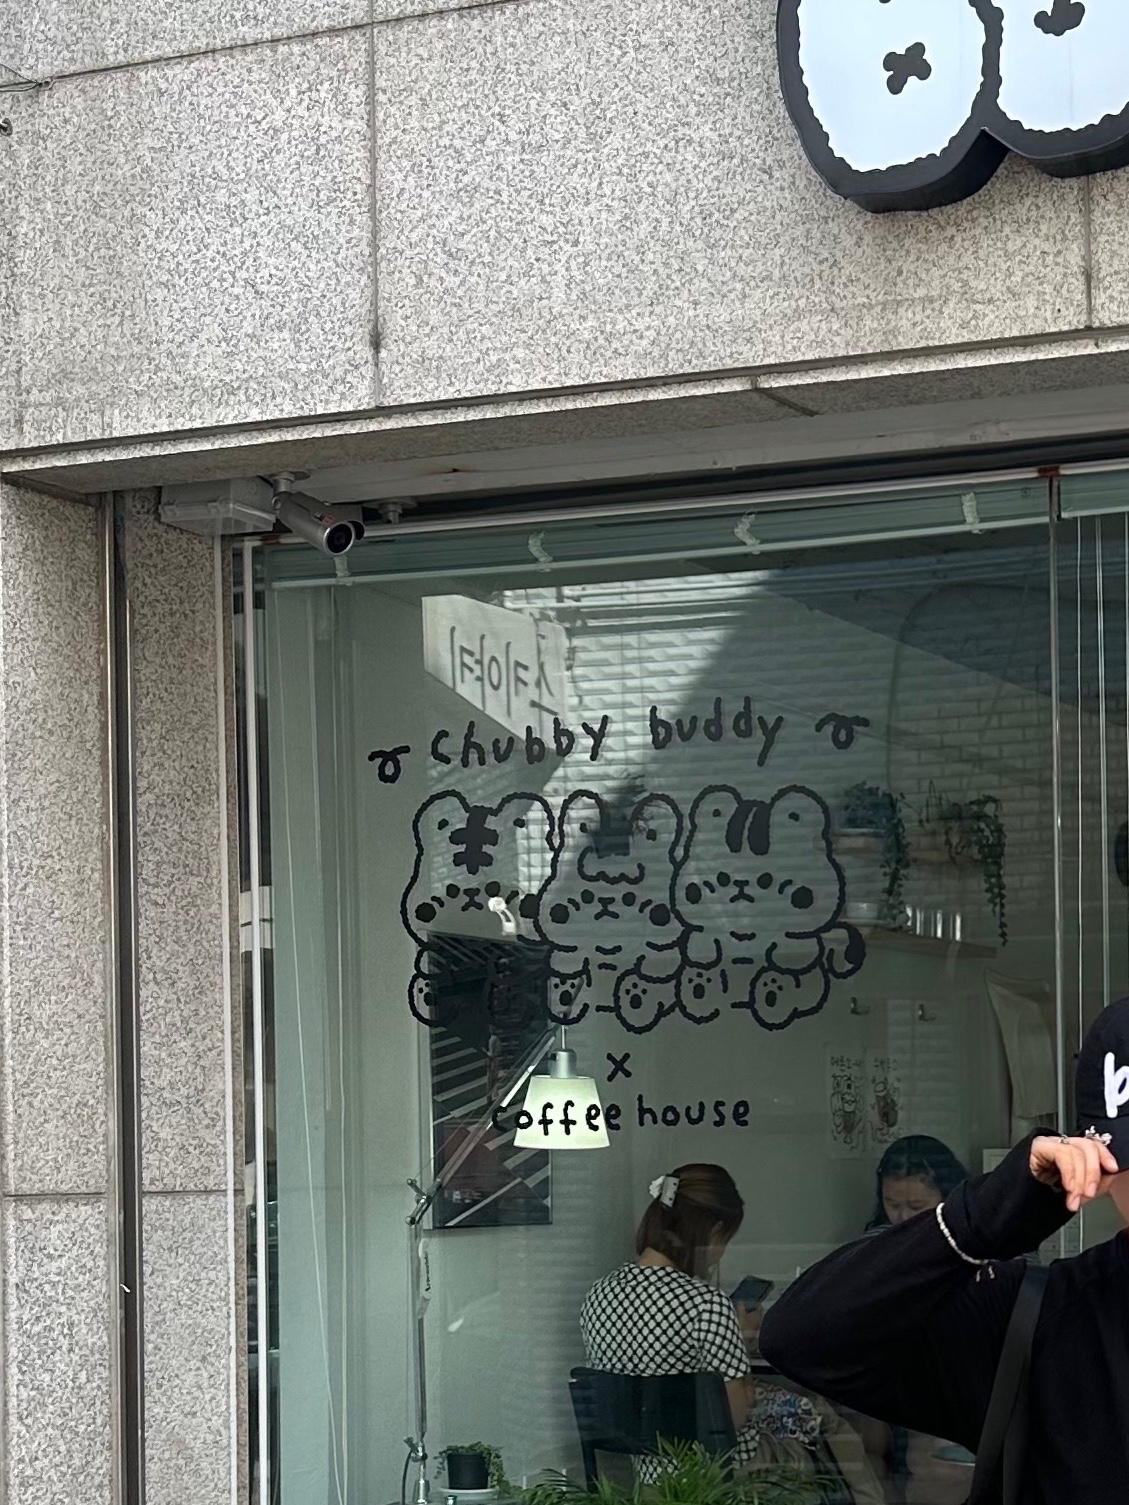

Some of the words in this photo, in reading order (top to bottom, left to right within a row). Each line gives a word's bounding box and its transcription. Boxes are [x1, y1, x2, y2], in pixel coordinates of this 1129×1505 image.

[431, 715, 609, 767] chubby
[650, 697, 783, 766] buddy
[492, 1100, 621, 1135] coffee
[638, 1094, 750, 1127] house
